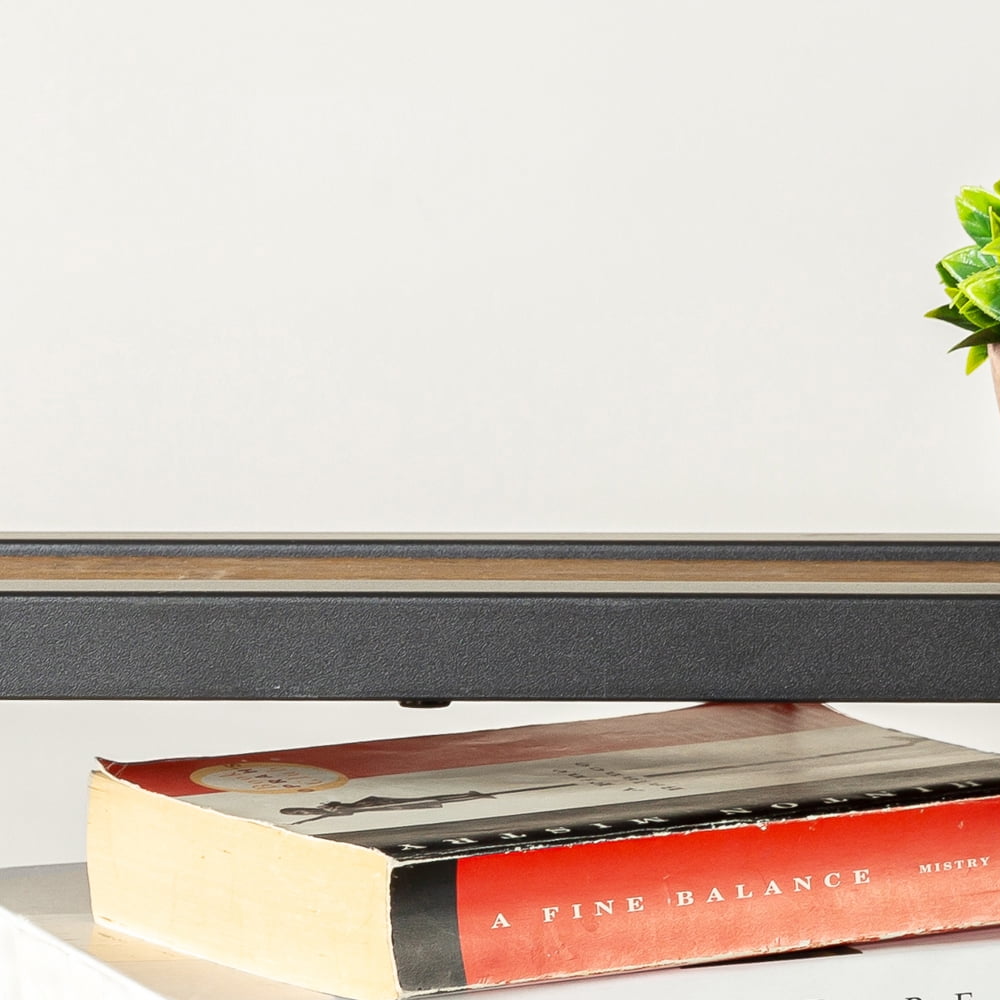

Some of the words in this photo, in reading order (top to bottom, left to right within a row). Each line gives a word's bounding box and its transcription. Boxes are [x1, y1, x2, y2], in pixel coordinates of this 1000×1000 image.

[919, 856, 990, 874] MISTRY
[491, 913, 511, 929] A
[542, 896, 644, 923] FINE
[676, 868, 872, 907] BALANCE
